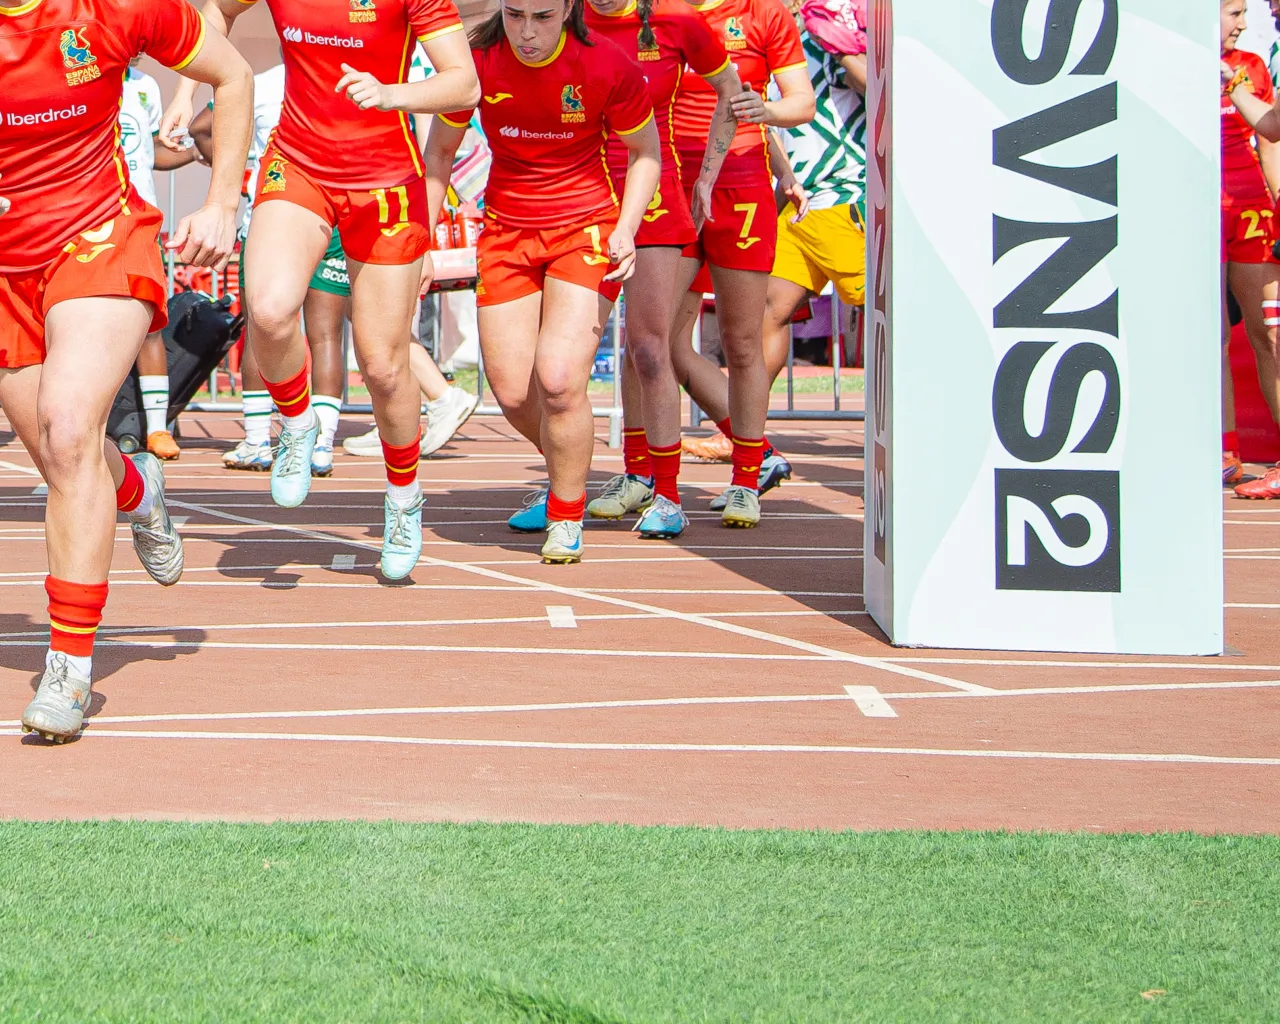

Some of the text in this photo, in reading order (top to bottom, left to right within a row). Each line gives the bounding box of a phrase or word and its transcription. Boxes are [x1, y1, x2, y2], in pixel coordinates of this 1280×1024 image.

[304, 31, 364, 48] Iberdrola
[65, 64, 100, 80] ESPAÑA
[67, 70, 102, 86] SEVENS
[6, 104, 87, 126] Iberdrola
[521, 130, 574, 139] Iberdrola
[369, 186, 409, 223] 11
[733, 203, 758, 238] 7
[583, 225, 602, 255] 1
